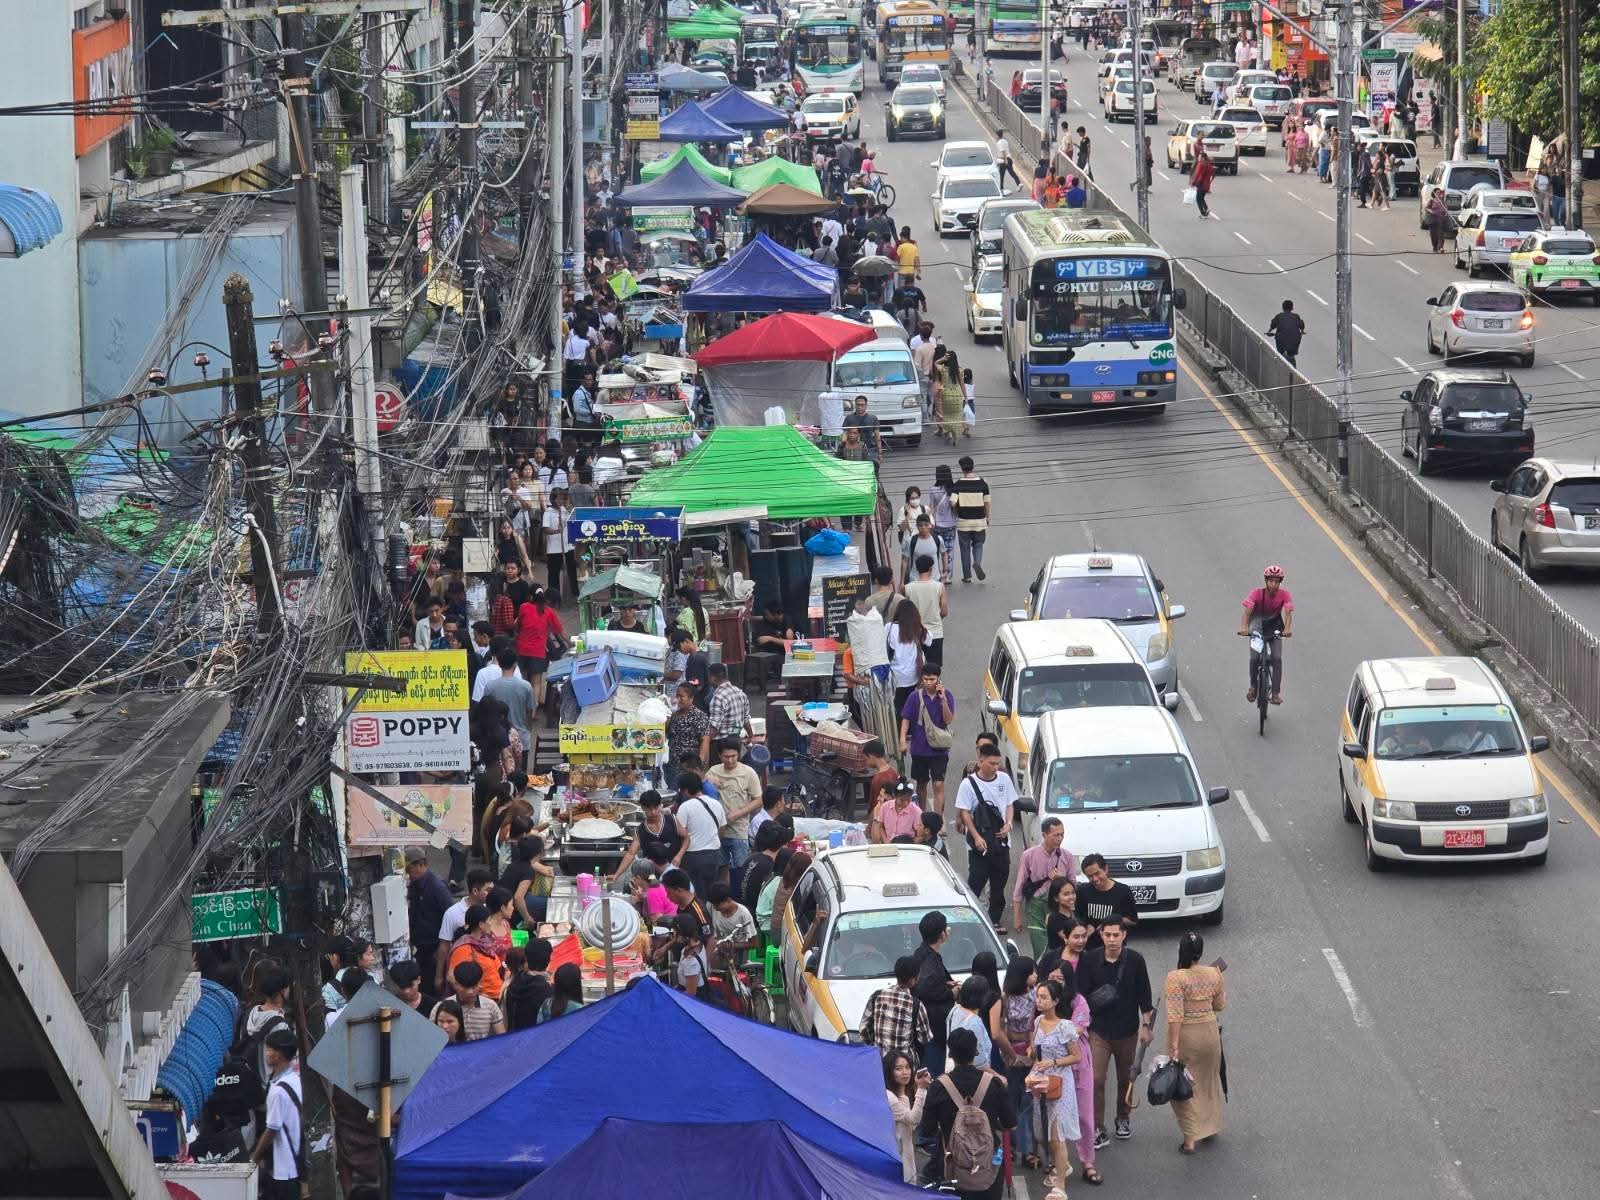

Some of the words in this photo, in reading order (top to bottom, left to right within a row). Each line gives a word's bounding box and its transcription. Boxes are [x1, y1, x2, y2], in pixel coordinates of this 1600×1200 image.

[1081, 261, 1121, 275] YBS
[1150, 349, 1173, 360] CNG
[382, 716, 463, 737] POPPY
[217, 920, 252, 933] Chan
